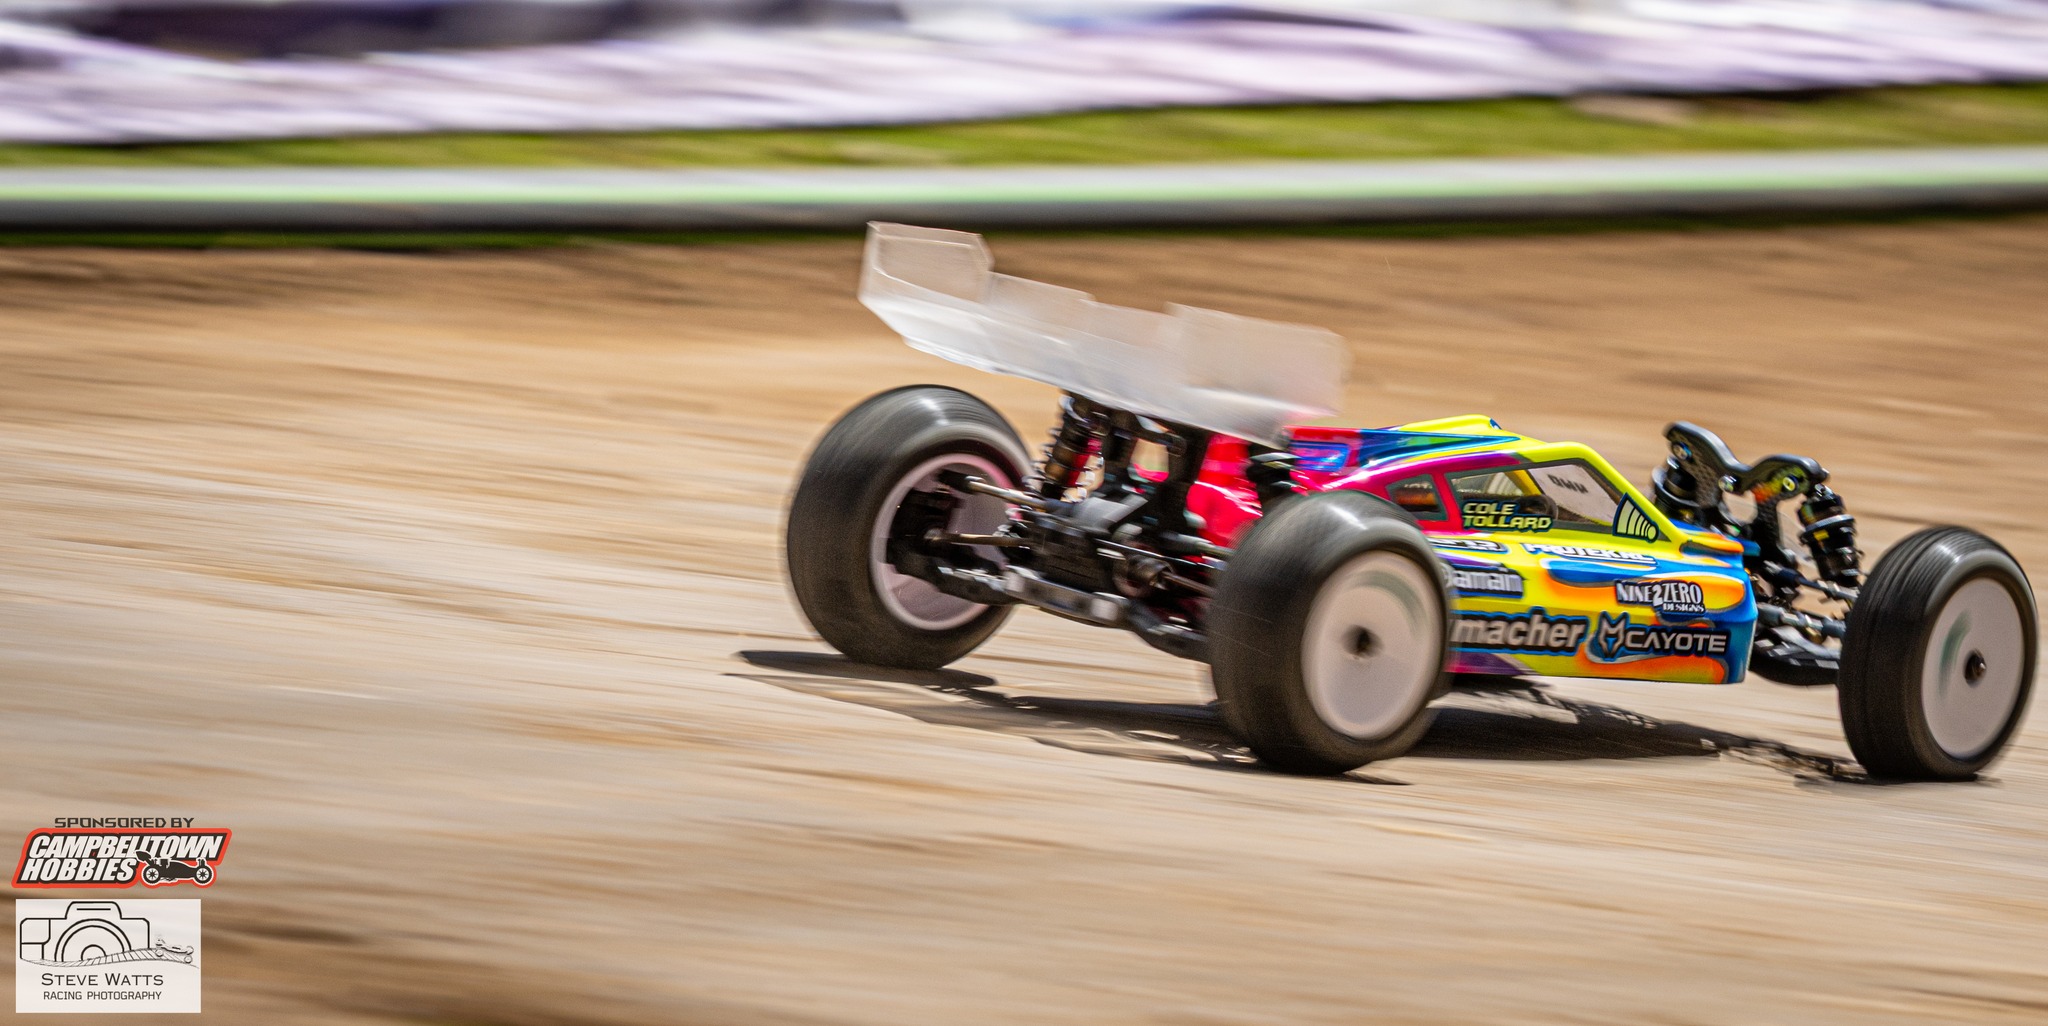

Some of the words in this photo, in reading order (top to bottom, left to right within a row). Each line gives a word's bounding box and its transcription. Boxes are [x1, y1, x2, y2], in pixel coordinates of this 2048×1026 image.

[1463, 502, 1517, 515] COLE
[1462, 515, 1552, 529] TOLLARD
[1662, 602, 1705, 613] DESIGNS
